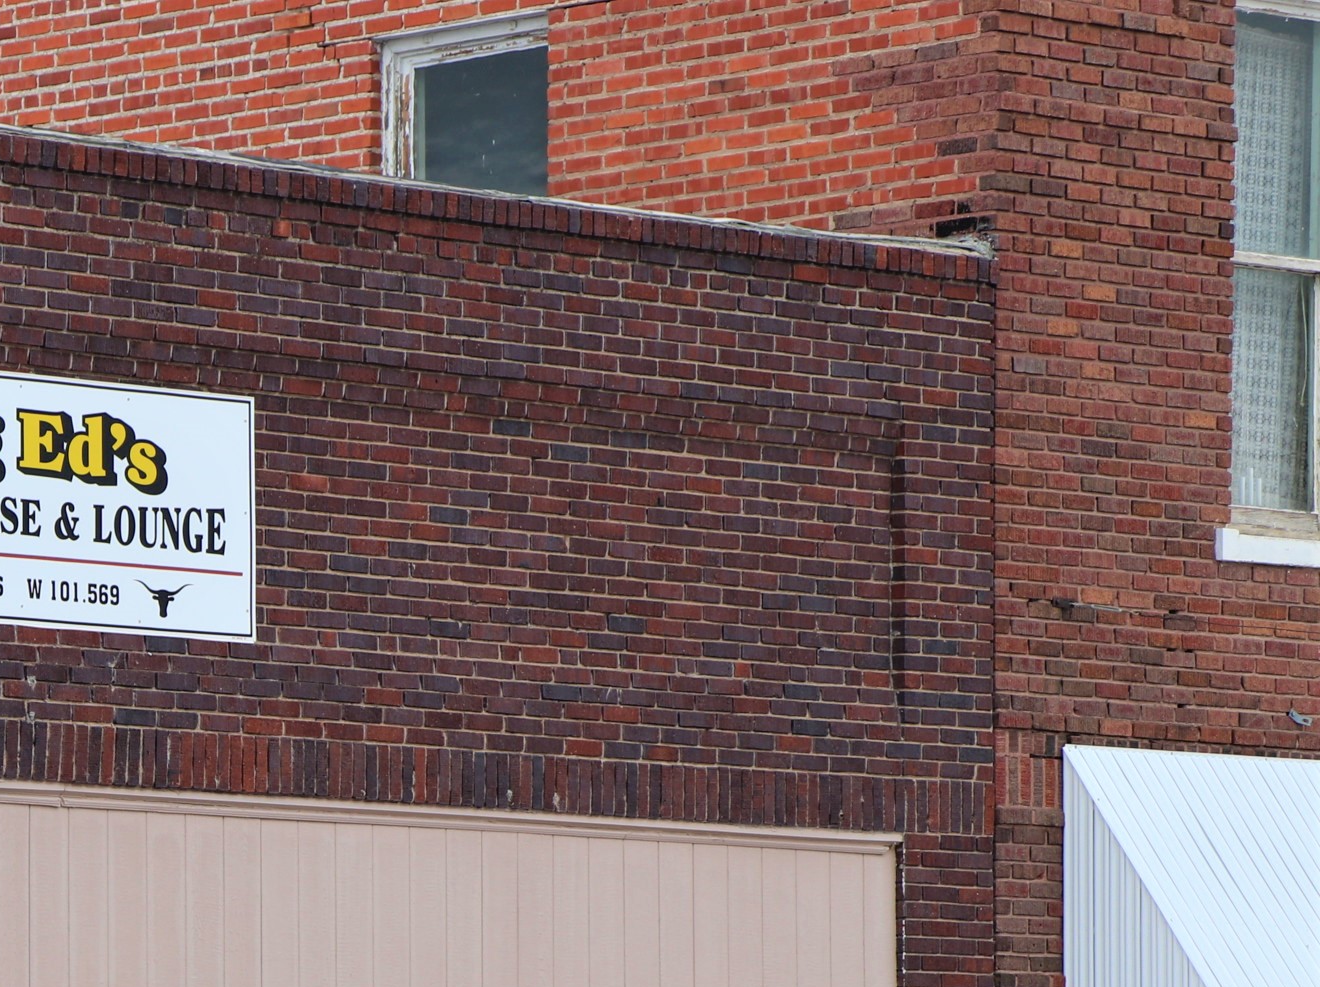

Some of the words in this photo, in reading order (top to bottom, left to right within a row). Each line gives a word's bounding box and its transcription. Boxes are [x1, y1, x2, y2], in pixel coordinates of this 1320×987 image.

[16, 408, 167, 495] Ed's
[54, 502, 80, 540] &
[93, 504, 226, 555] LOUNGE
[27, 578, 42, 600] W
[50, 580, 120, 606] 101.569
